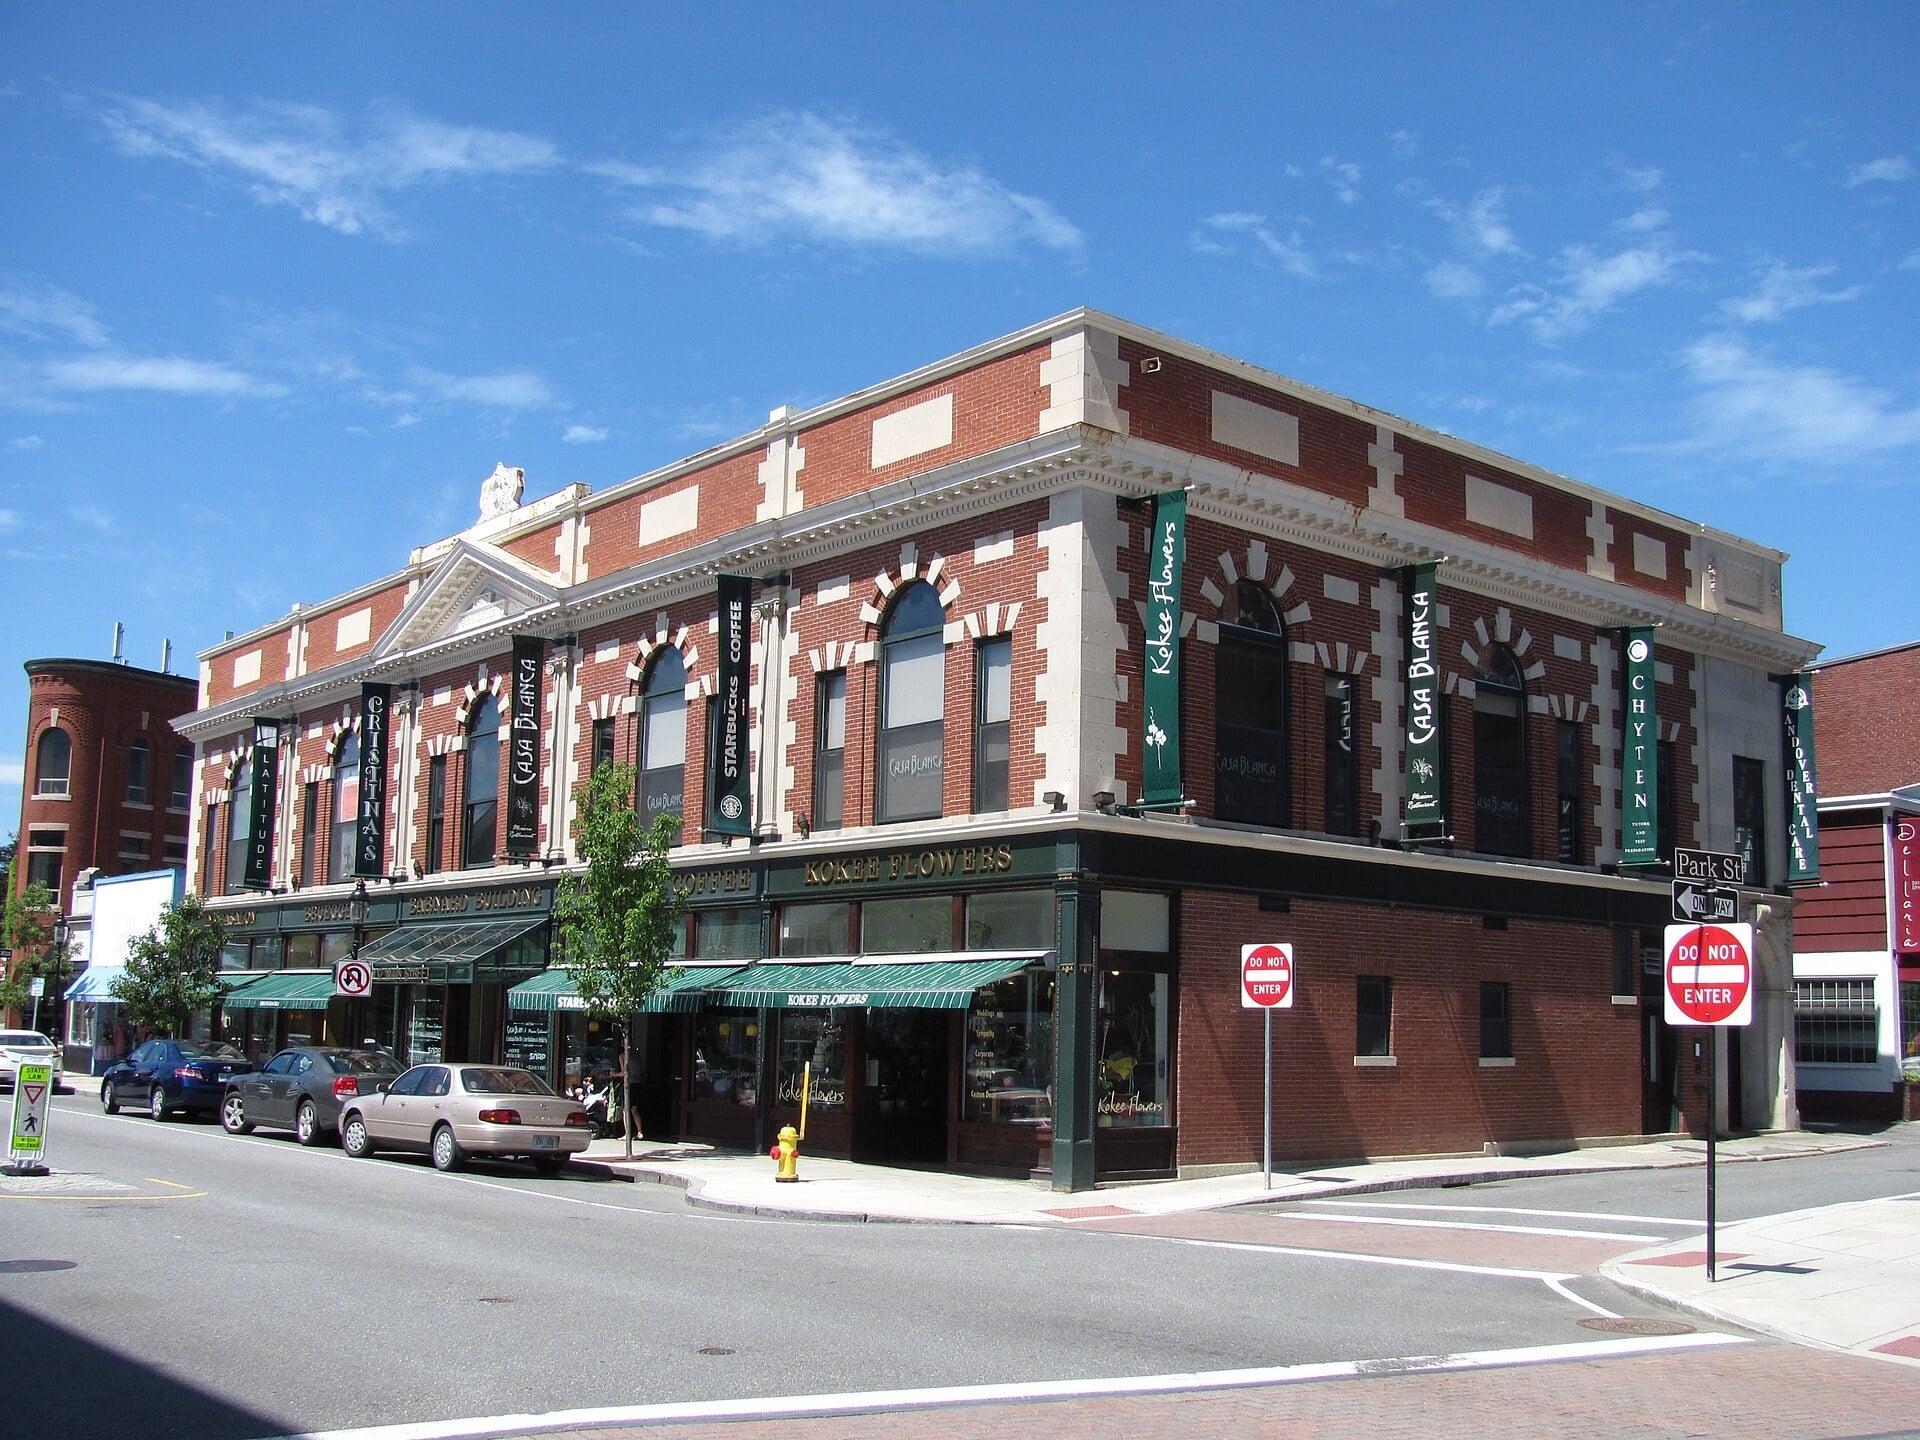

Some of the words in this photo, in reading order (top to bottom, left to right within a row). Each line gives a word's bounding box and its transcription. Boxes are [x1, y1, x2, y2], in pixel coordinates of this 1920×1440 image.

[1149, 521, 1176, 604] Flowers
[730, 601, 742, 663] COFFEE
[1146, 608, 1173, 674] Kokee
[1408, 591, 1435, 678] BLANCA
[514, 659, 538, 730] BLANCA
[1408, 688, 1435, 744] CASA
[724, 676, 738, 778] STARBUCKS
[1632, 675, 1647, 808] CHYTEN
[513, 740, 537, 784] CASA
[1784, 713, 1814, 794] ANDOVER
[363, 696, 383, 861] CRISTINA'S
[256, 754, 271, 869] LATITUDE
[1786, 770, 1814, 839] DENTAL
[804, 855, 881, 887] KOKEE
[888, 843, 1013, 881] FLOWERS
[1678, 853, 1718, 878] Park
[1723, 858, 1741, 880] St
[1788, 823, 1807, 870] CARE
[409, 894, 469, 916] BARNARD
[475, 887, 543, 911] BUILDING
[672, 868, 751, 895] COFFEE
[1897, 823, 1918, 947] Dellaria
[1692, 896, 1706, 913] ON
[404, 968, 430, 980] STREET
[1250, 957, 1263, 967] DO
[1267, 956, 1284, 967] NOT
[1678, 946, 1699, 960] DO
[1708, 945, 1737, 959] NOT
[787, 994, 819, 1006] KOKEE
[820, 994, 869, 1006] FLOWERS
[1253, 984, 1281, 994] ENTER
[1684, 988, 1732, 1004] ENTER
[808, 1074, 844, 1105] Flowers
[1098, 1090, 1126, 1114] Kokee
[1126, 1090, 1163, 1116] Flowers
